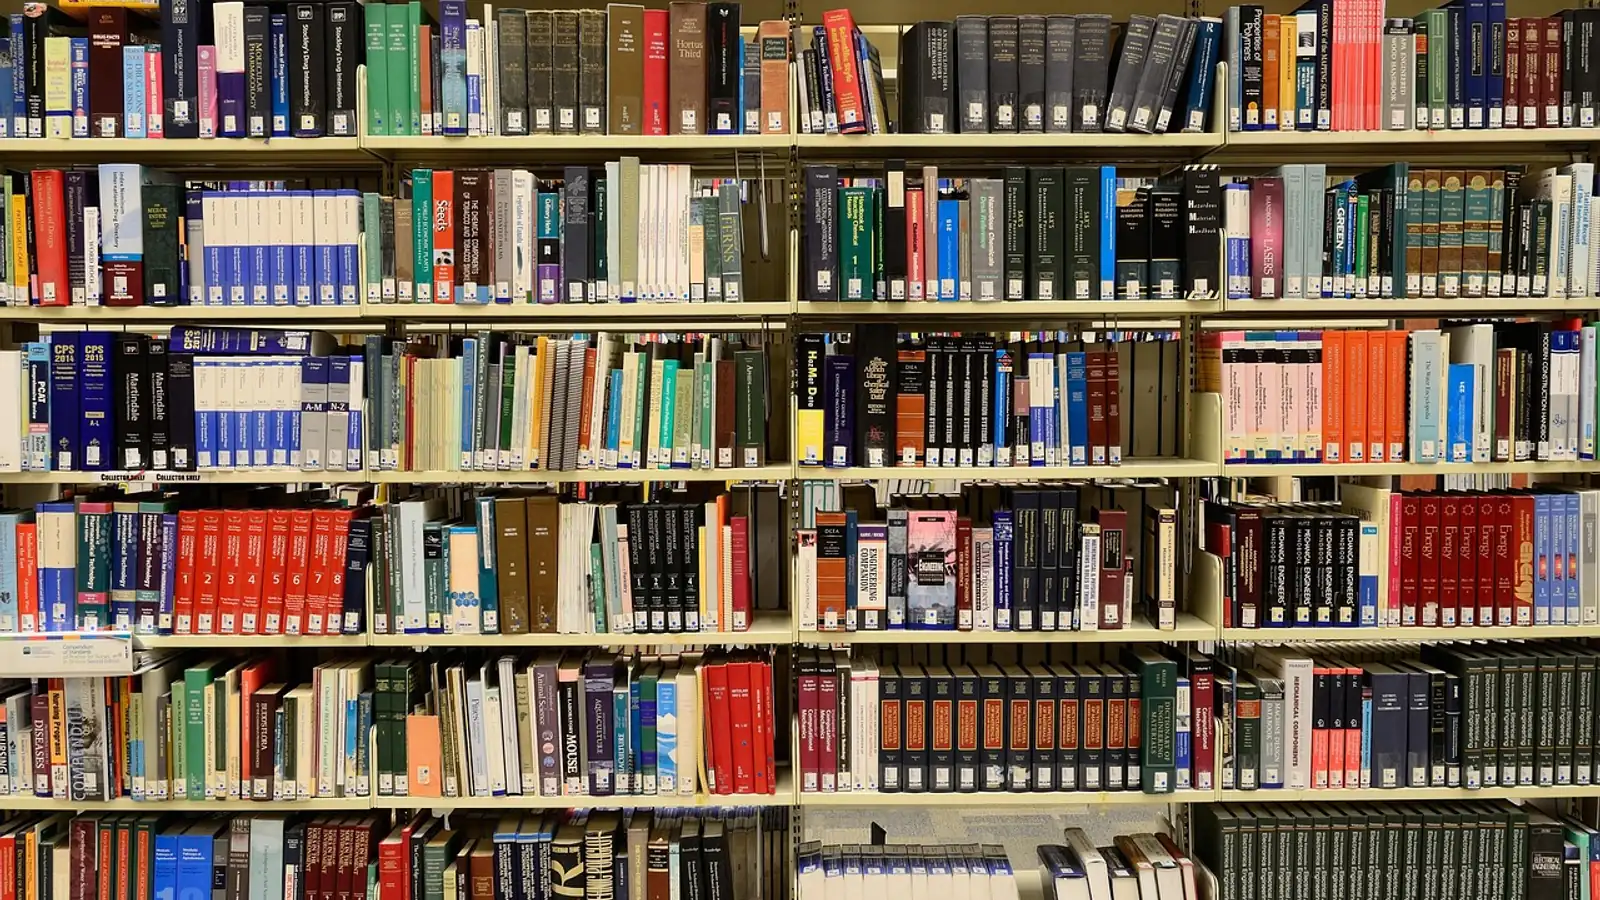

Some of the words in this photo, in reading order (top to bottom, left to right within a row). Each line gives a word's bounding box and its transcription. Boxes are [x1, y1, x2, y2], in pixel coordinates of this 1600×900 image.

[1252, 9, 1263, 51] Properties
[1321, 4, 1329, 37] GLOSSARY
[335, 26, 343, 57] Stockley's
[677, 40, 703, 48] Hortus
[678, 49, 701, 58] Third
[838, 27, 849, 62] Scientific
[844, 62, 853, 83] Style
[1243, 22, 1254, 61] Polymers
[301, 56, 309, 71] Drug
[335, 58, 343, 73] Drug
[1254, 53, 1263, 61] of
[1320, 53, 1328, 83] MAPPING
[249, 42, 257, 109] PHARMACOLOGY
[77, 87, 85, 107] GUIDE
[336, 73, 344, 108] Interactions
[1319, 83, 1328, 110] SCIENC
[45, 177, 54, 215] Dictionary
[1577, 184, 1583, 192] of
[48, 216, 55, 225] of
[112, 209, 120, 223] Drug
[436, 199, 448, 232] Seeds
[858, 222, 865, 231] of
[1336, 208, 1345, 250] GREEN
[48, 226, 56, 249] Drugs
[720, 217, 733, 263] FERNS
[1266, 228, 1272, 236] OF
[463, 238, 471, 263] TOBACCO
[1263, 238, 1273, 275] LASERS
[55, 345, 75, 354] CPS
[55, 354, 75, 363] 2014
[85, 345, 104, 354] CPS
[85, 354, 103, 362] 2015
[807, 350, 818, 385] HazMat
[38, 381, 46, 403] PCAT
[130, 372, 139, 421] Martindale
[156, 372, 165, 420] Martindale
[807, 387, 818, 408] Data
[1424, 386, 1432, 420] Encyclopedia
[305, 403, 323, 411] A-M
[331, 403, 346, 411] N-Z
[156, 473, 185, 481] COLLECTOR
[982, 542, 990, 569] CIVIL
[1403, 526, 1418, 559] Energy
[1423, 526, 1438, 559] Energy
[1443, 526, 1457, 559] Energy
[1461, 526, 1475, 559] Energy
[1479, 526, 1494, 559] Energy
[1497, 526, 1512, 559] Energy
[205, 574, 211, 584] 2
[228, 574, 234, 584] 3
[273, 574, 279, 584] 5
[293, 574, 300, 584] 6
[334, 574, 341, 584] 8
[861, 548, 869, 592] COMPANION
[869, 548, 877, 601] ENGINEERING
[1514, 541, 1533, 604] energy
[981, 570, 990, 611] Engineer's
[537, 672, 546, 699] Animal
[52, 693, 61, 719] Nursing
[471, 698, 480, 721] Pines
[538, 700, 547, 725] Science
[52, 722, 61, 756] Programs
[595, 698, 603, 754] AQUACULTURE
[34, 719, 44, 768] DISEASES
[567, 733, 578, 773] MOUSE
[1164, 751, 1171, 761] OF
[585, 835, 613, 874] POLIGLOT
